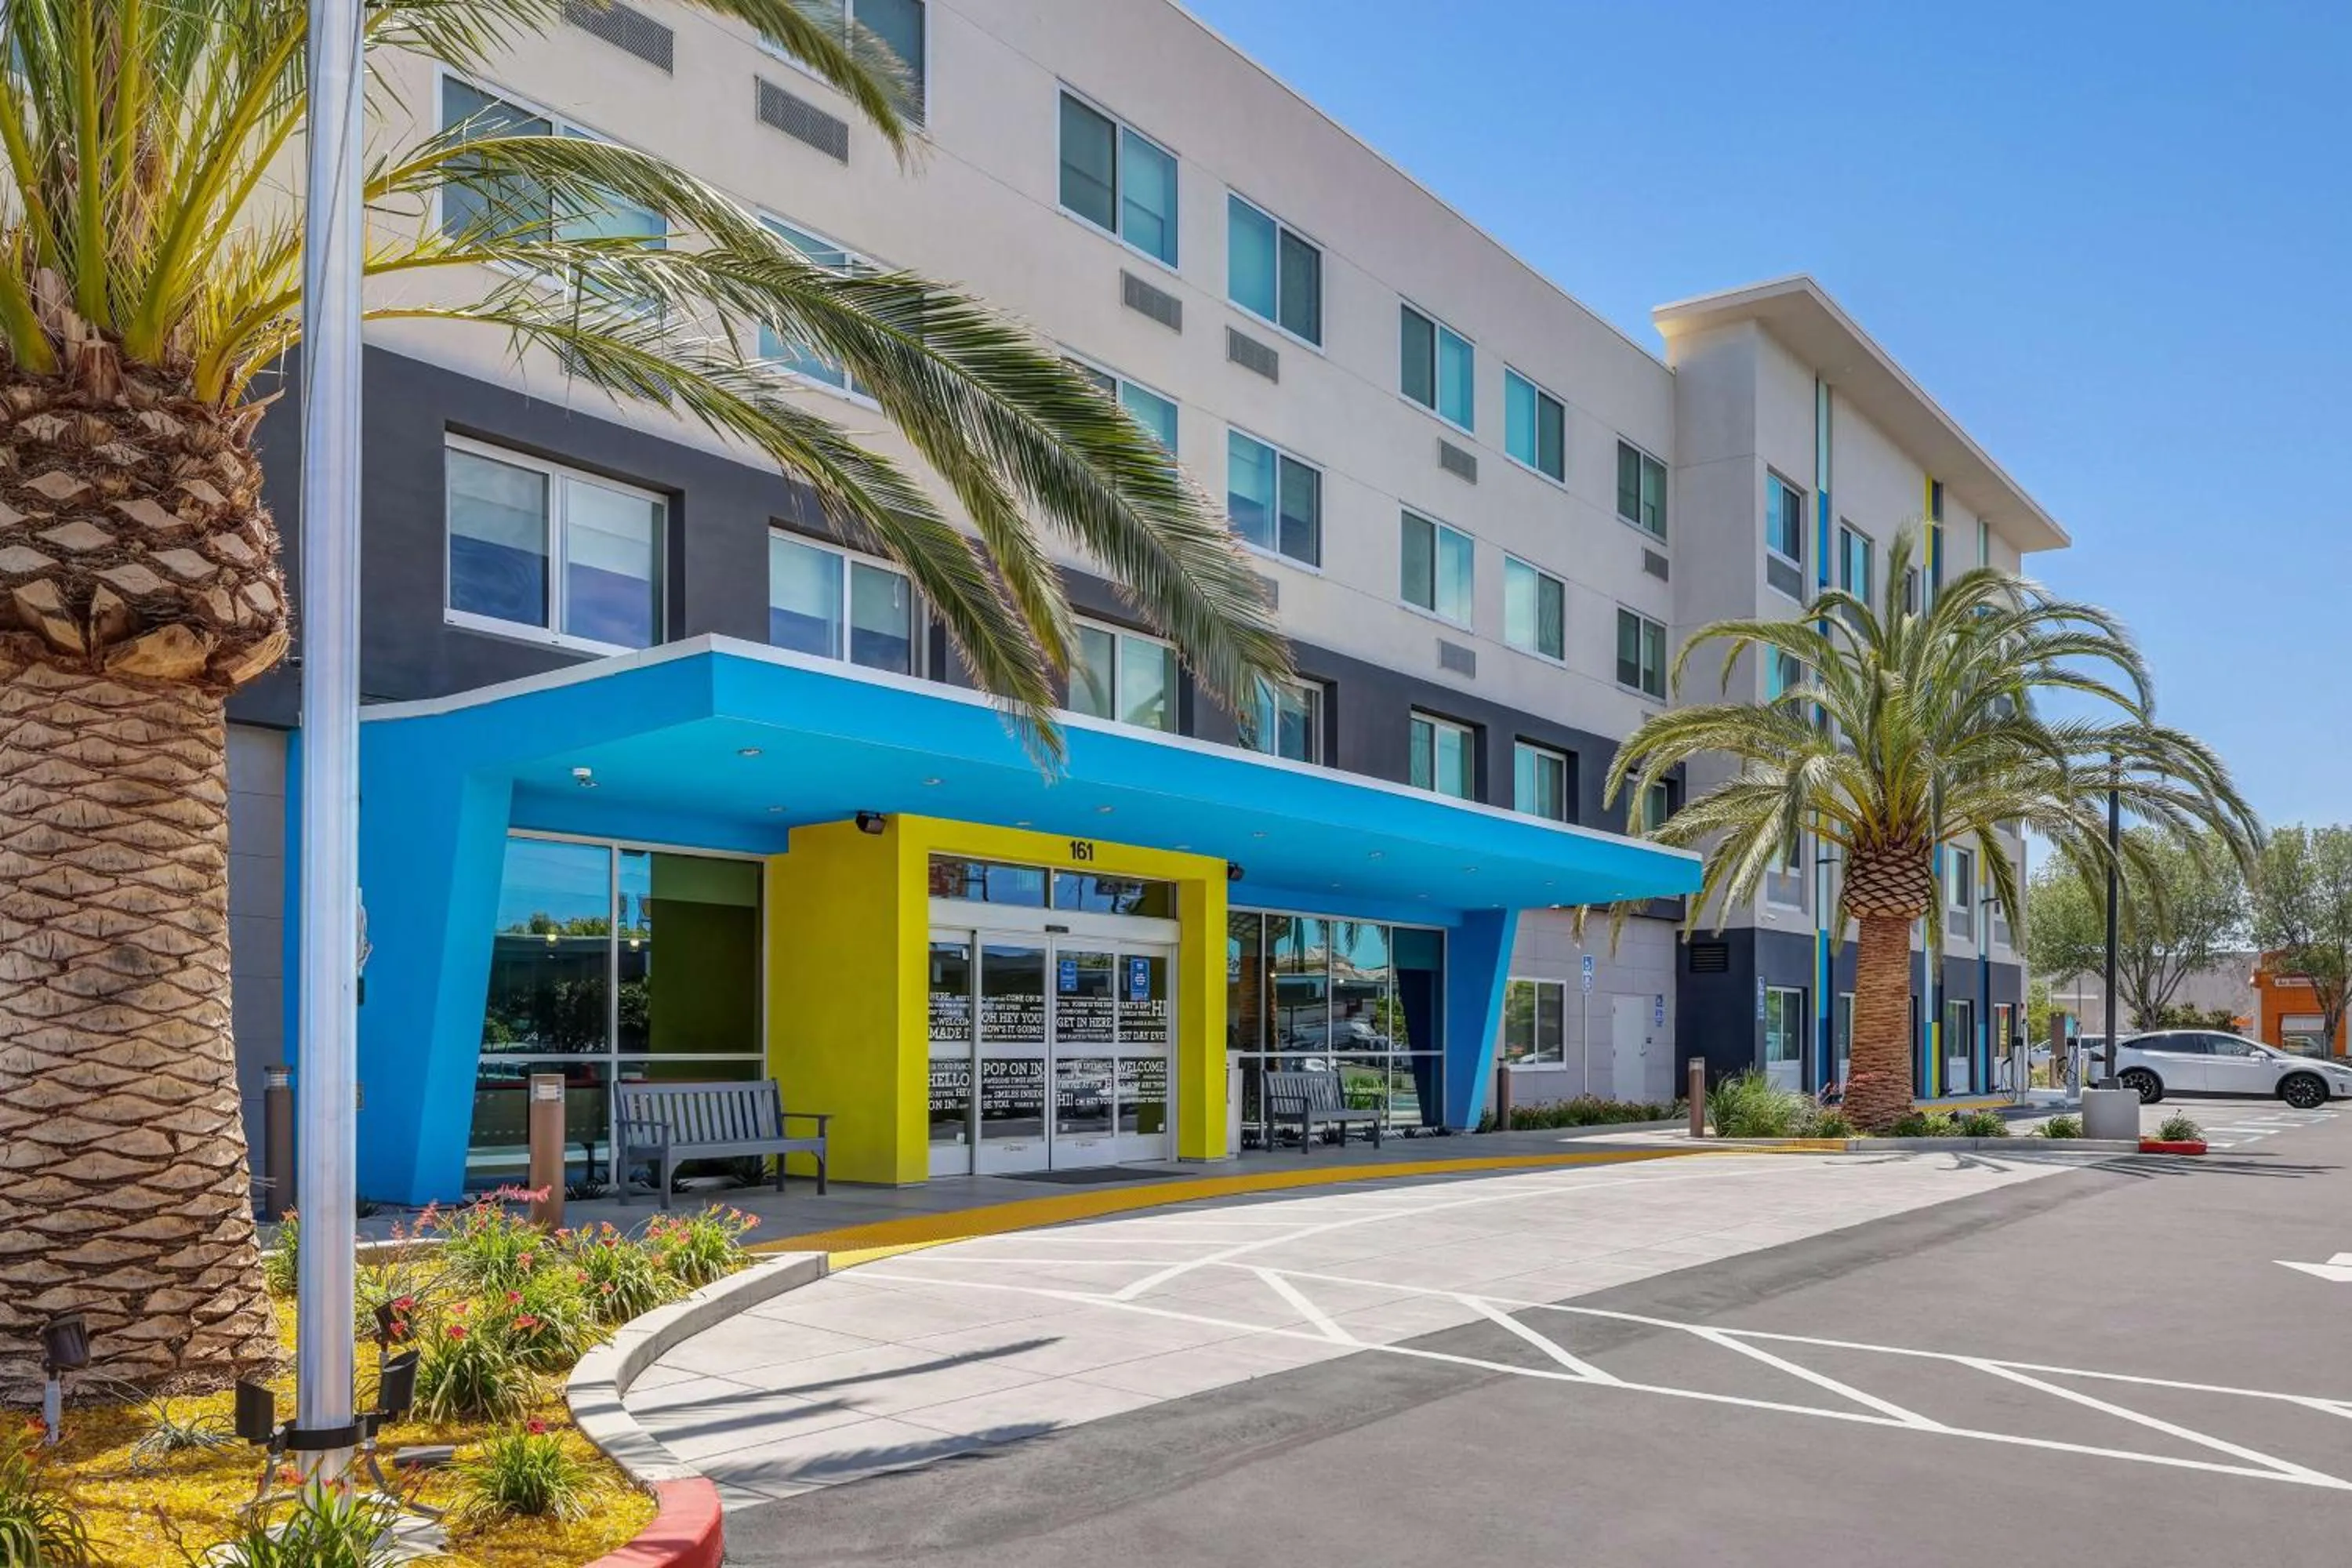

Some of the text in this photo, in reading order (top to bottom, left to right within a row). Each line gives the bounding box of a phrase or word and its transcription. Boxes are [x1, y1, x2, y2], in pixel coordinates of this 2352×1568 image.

[1070, 840, 1094, 861] 161
[981, 1012, 998, 1023] OH
[999, 1012, 1020, 1023] HEY
[1057, 1017, 1074, 1028] GET
[1076, 1017, 1087, 1027] IN
[1088, 1017, 1112, 1028] HERE
[928, 1027, 963, 1040] MADE
[982, 1062, 1007, 1076] POP
[1009, 1062, 1028, 1076] ON
[928, 1073, 970, 1087] HELLO
[1056, 1094, 1073, 1106] HI!
